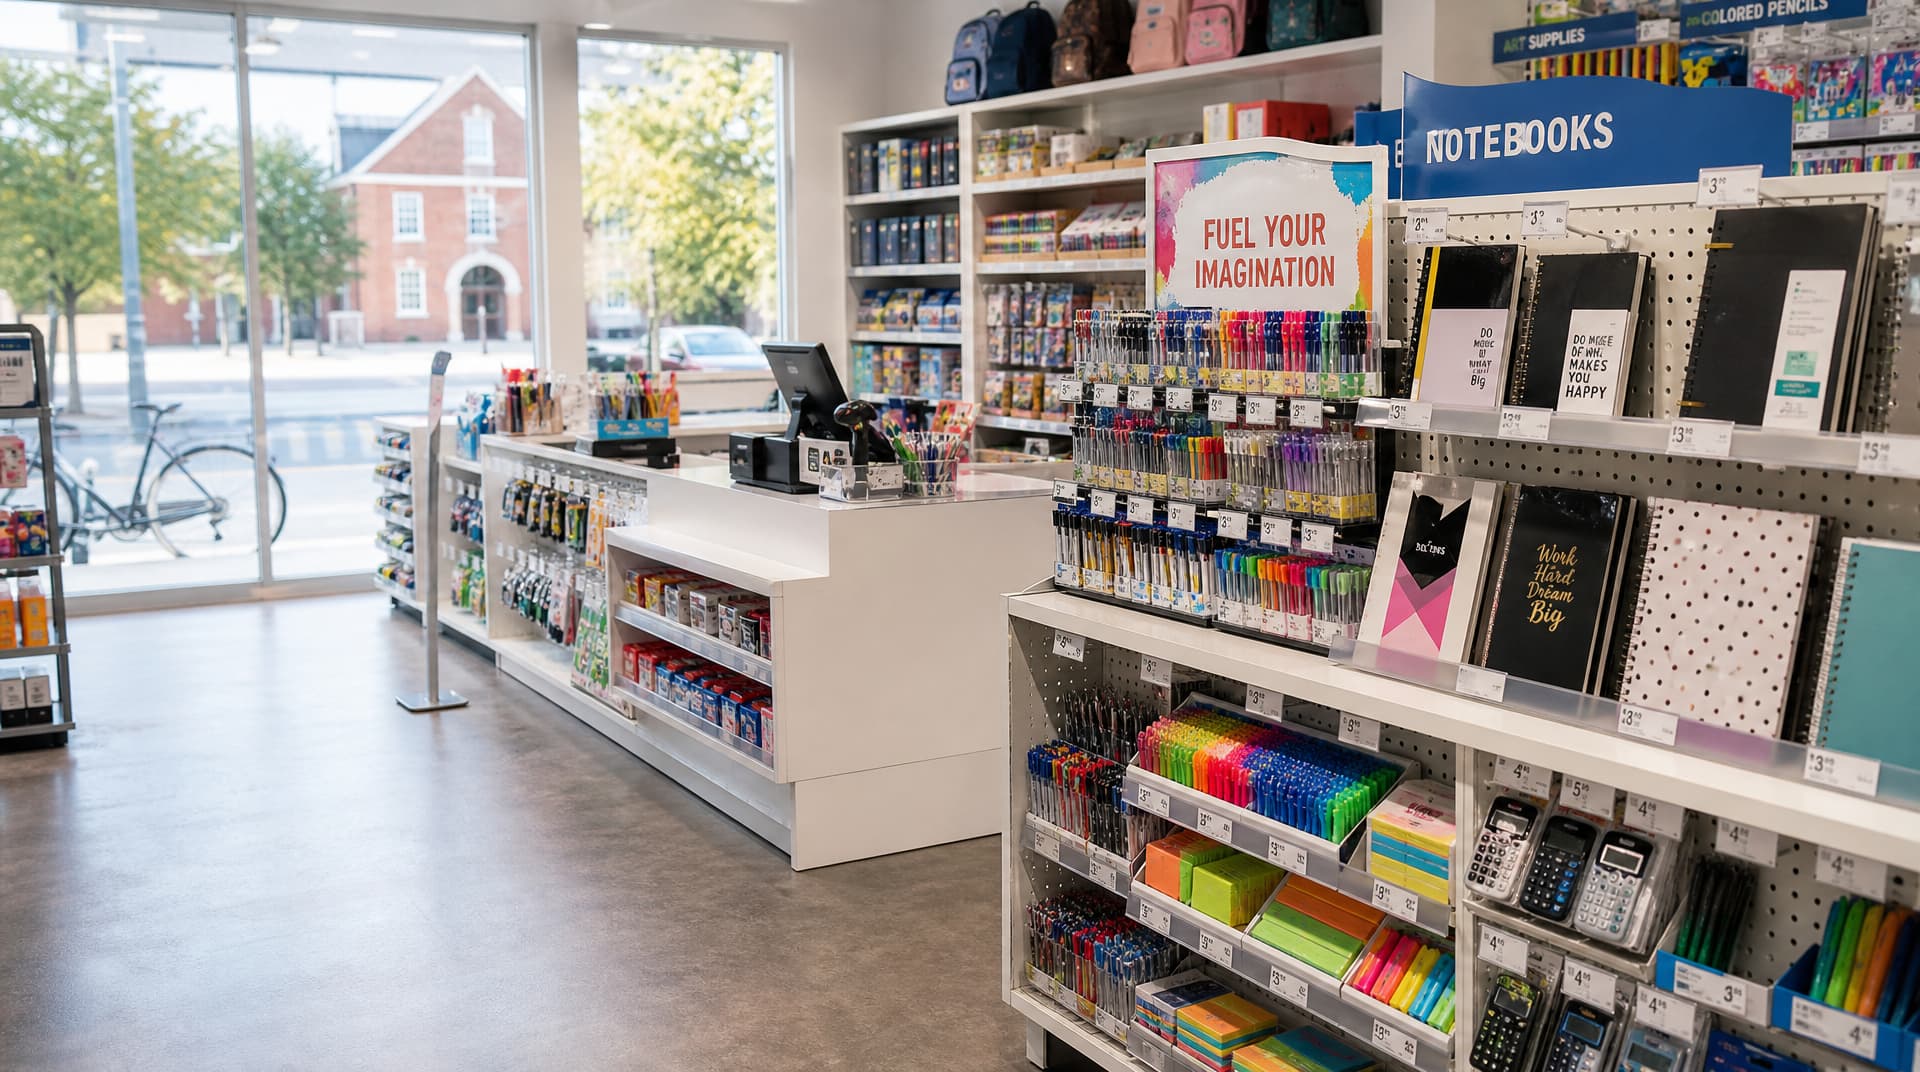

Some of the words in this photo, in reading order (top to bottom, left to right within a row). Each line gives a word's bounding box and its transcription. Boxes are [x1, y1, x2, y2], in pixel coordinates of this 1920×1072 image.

[1702, 3, 1763, 26] COLORED
[1503, 35, 1527, 54] ART
[1528, 28, 1586, 50] SUPPLIES
[1426, 111, 1614, 164] NOTEBOOKS
[1204, 217, 1256, 250] FUEL
[1264, 212, 1326, 247] YOUR
[1195, 255, 1335, 288] IMAGINATION
[1480, 327, 1493, 338] DO
[1573, 334, 1586, 345] DO
[1571, 346, 1584, 357] OF
[1569, 359, 1608, 372] MAKES
[1569, 372, 1590, 383] YOU
[1566, 385, 1607, 399] HAPPY
[1537, 543, 1578, 566] Work
[1534, 564, 1575, 586] Hard
[1526, 581, 1575, 603] Dream
[1528, 600, 1566, 632] Big
